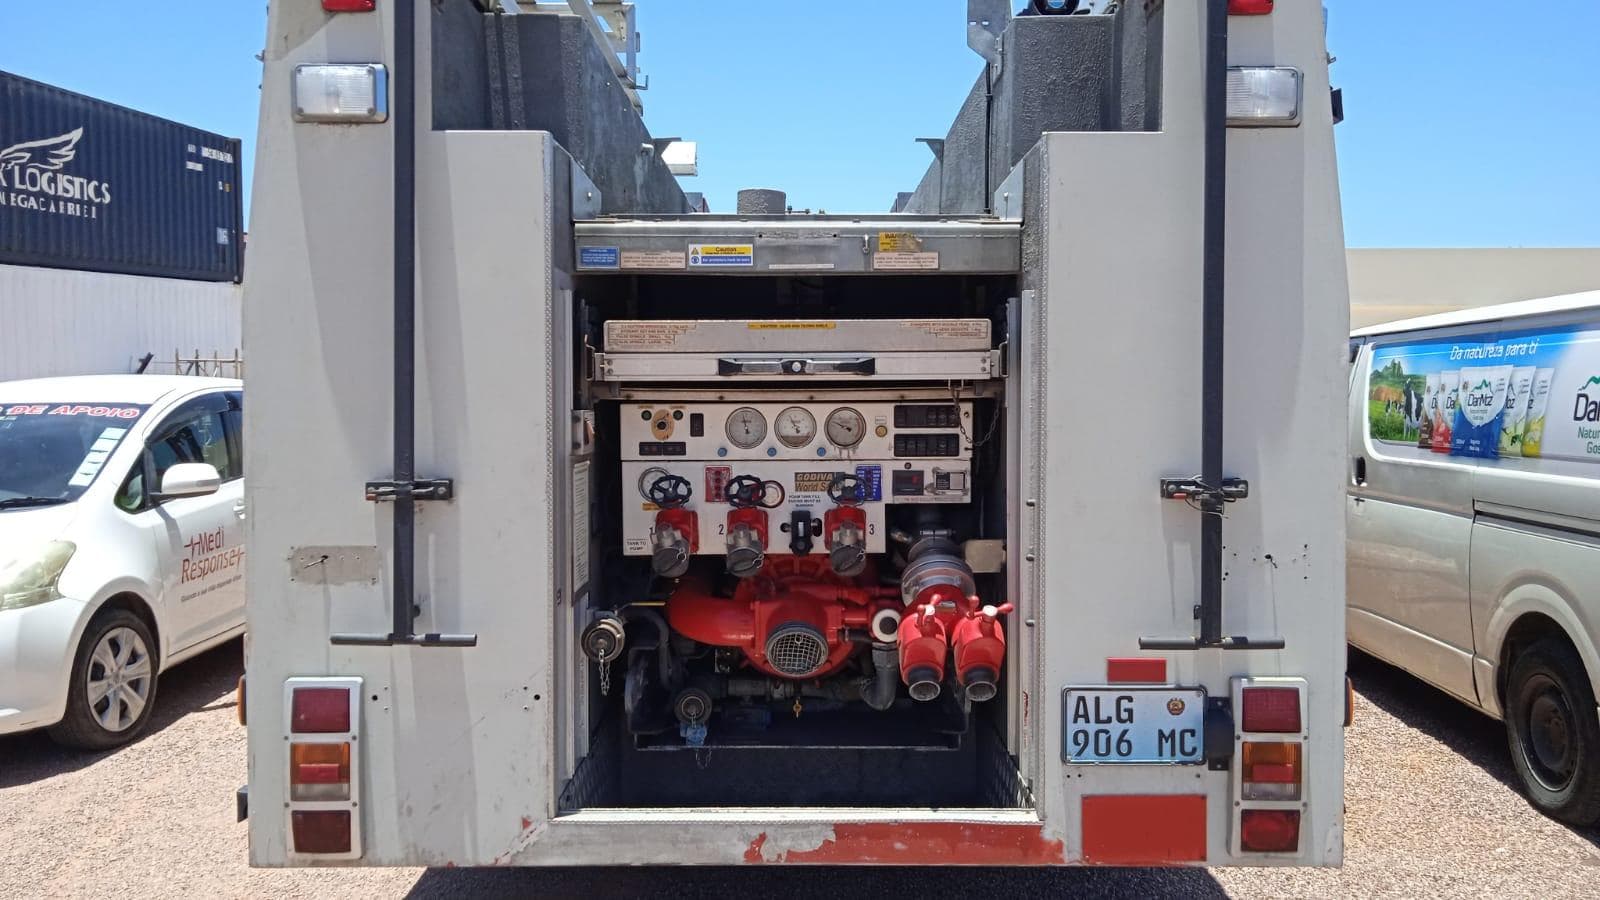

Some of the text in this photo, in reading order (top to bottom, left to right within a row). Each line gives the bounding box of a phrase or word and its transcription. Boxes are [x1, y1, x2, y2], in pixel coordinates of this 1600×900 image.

[14, 165, 111, 204] LOGISTICS
[1463, 345, 1502, 359] natureza
[1504, 342, 1526, 360] para
[6, 405, 140, 419] DE APOIO
[797, 473, 833, 481] GODIVA
[795, 481, 818, 492] World
[718, 524, 724, 535] 2
[869, 524, 875, 535] 3
[198, 526, 225, 556] Medi
[181, 549, 236, 584] Response
[1073, 695, 1134, 724] ALG
[1072, 728, 1197, 757] 906 MC
